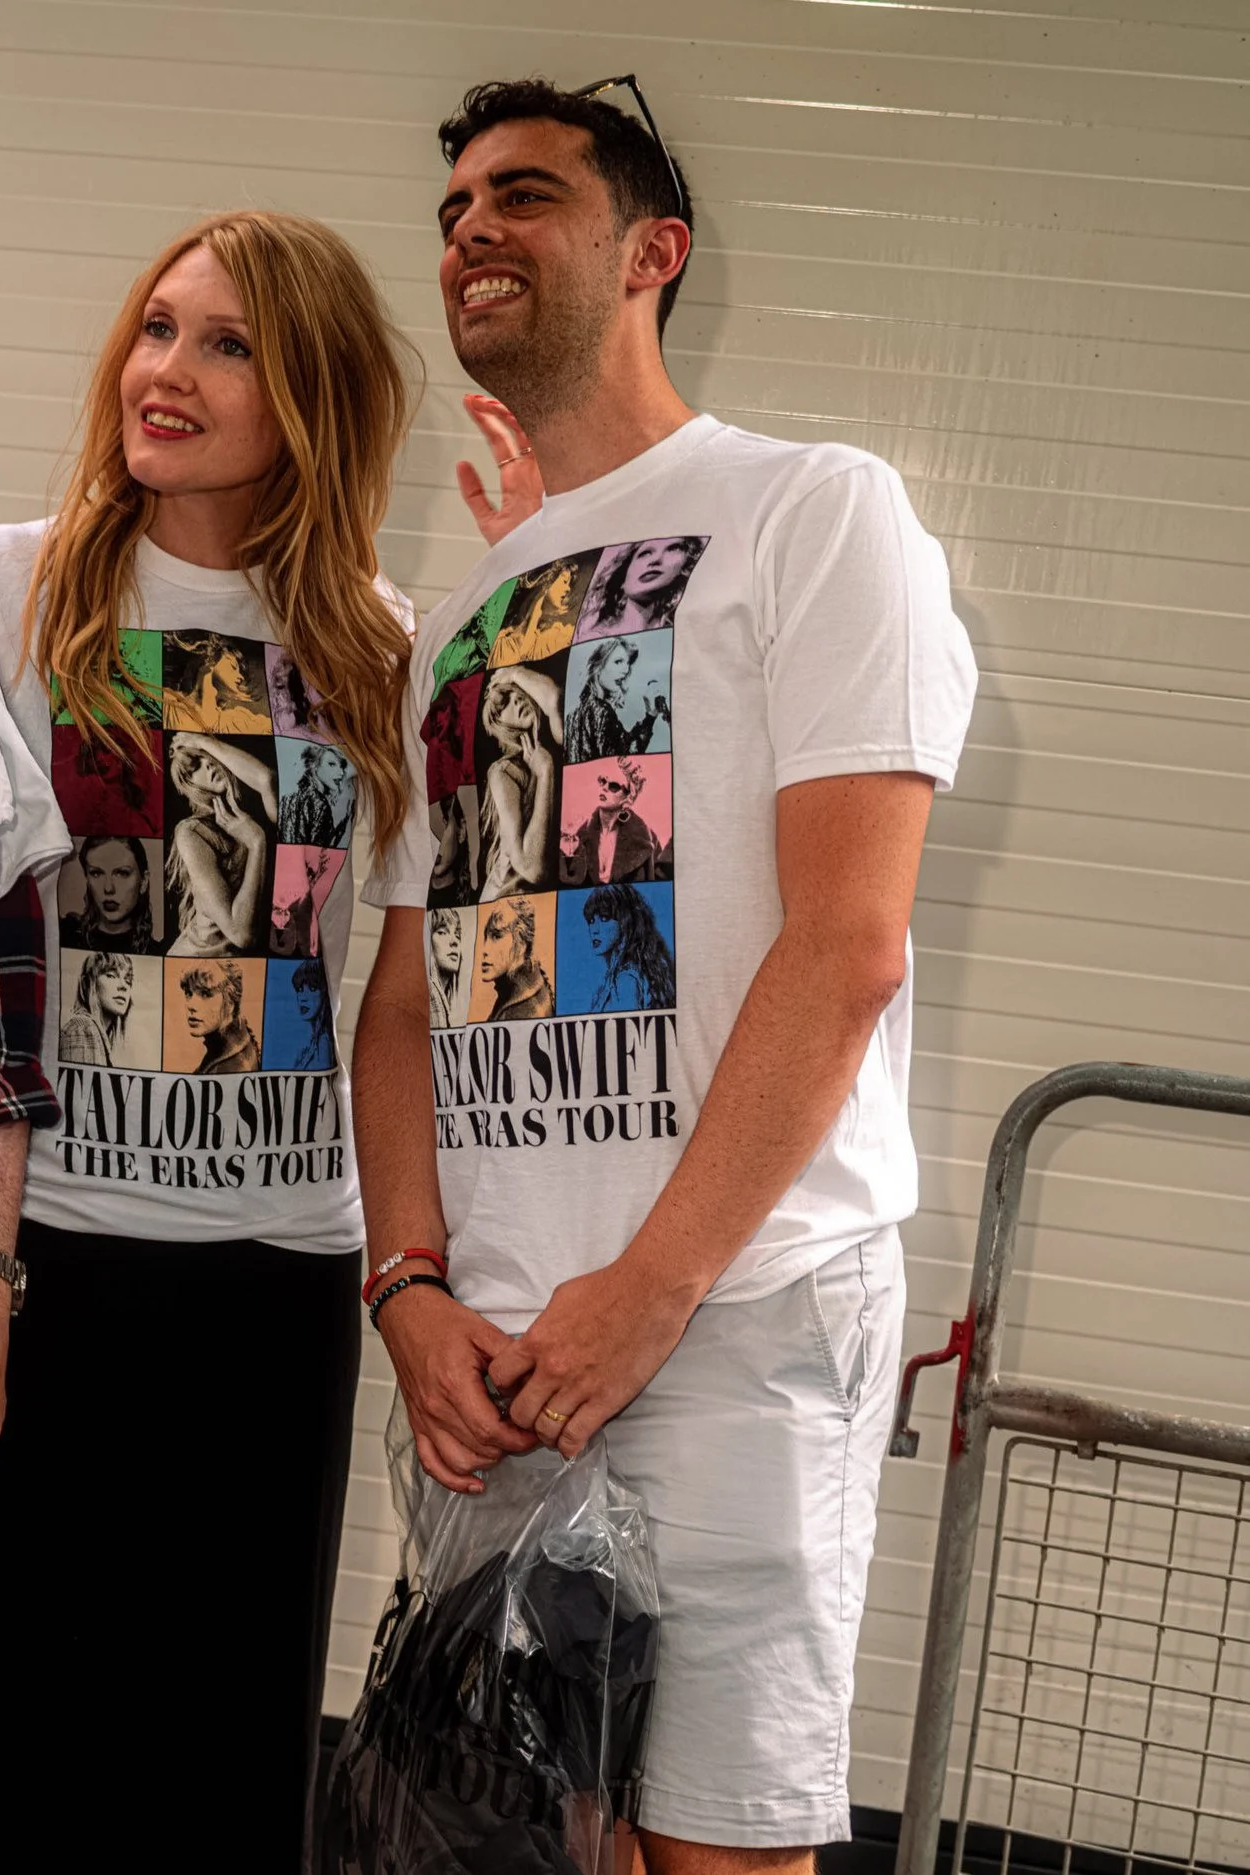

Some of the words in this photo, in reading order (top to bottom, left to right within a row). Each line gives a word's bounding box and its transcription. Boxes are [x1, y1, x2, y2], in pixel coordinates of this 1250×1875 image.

[529, 1014, 678, 1103] SWIFT
[56, 1067, 225, 1150] TAYLOR
[235, 1071, 342, 1150] SWIFT
[436, 1113, 464, 1149] TE
[558, 1100, 679, 1145] TOUR
[56, 1141, 139, 1181] THE
[150, 1154, 245, 1189] ERAS
[257, 1146, 344, 1187] TOUR
